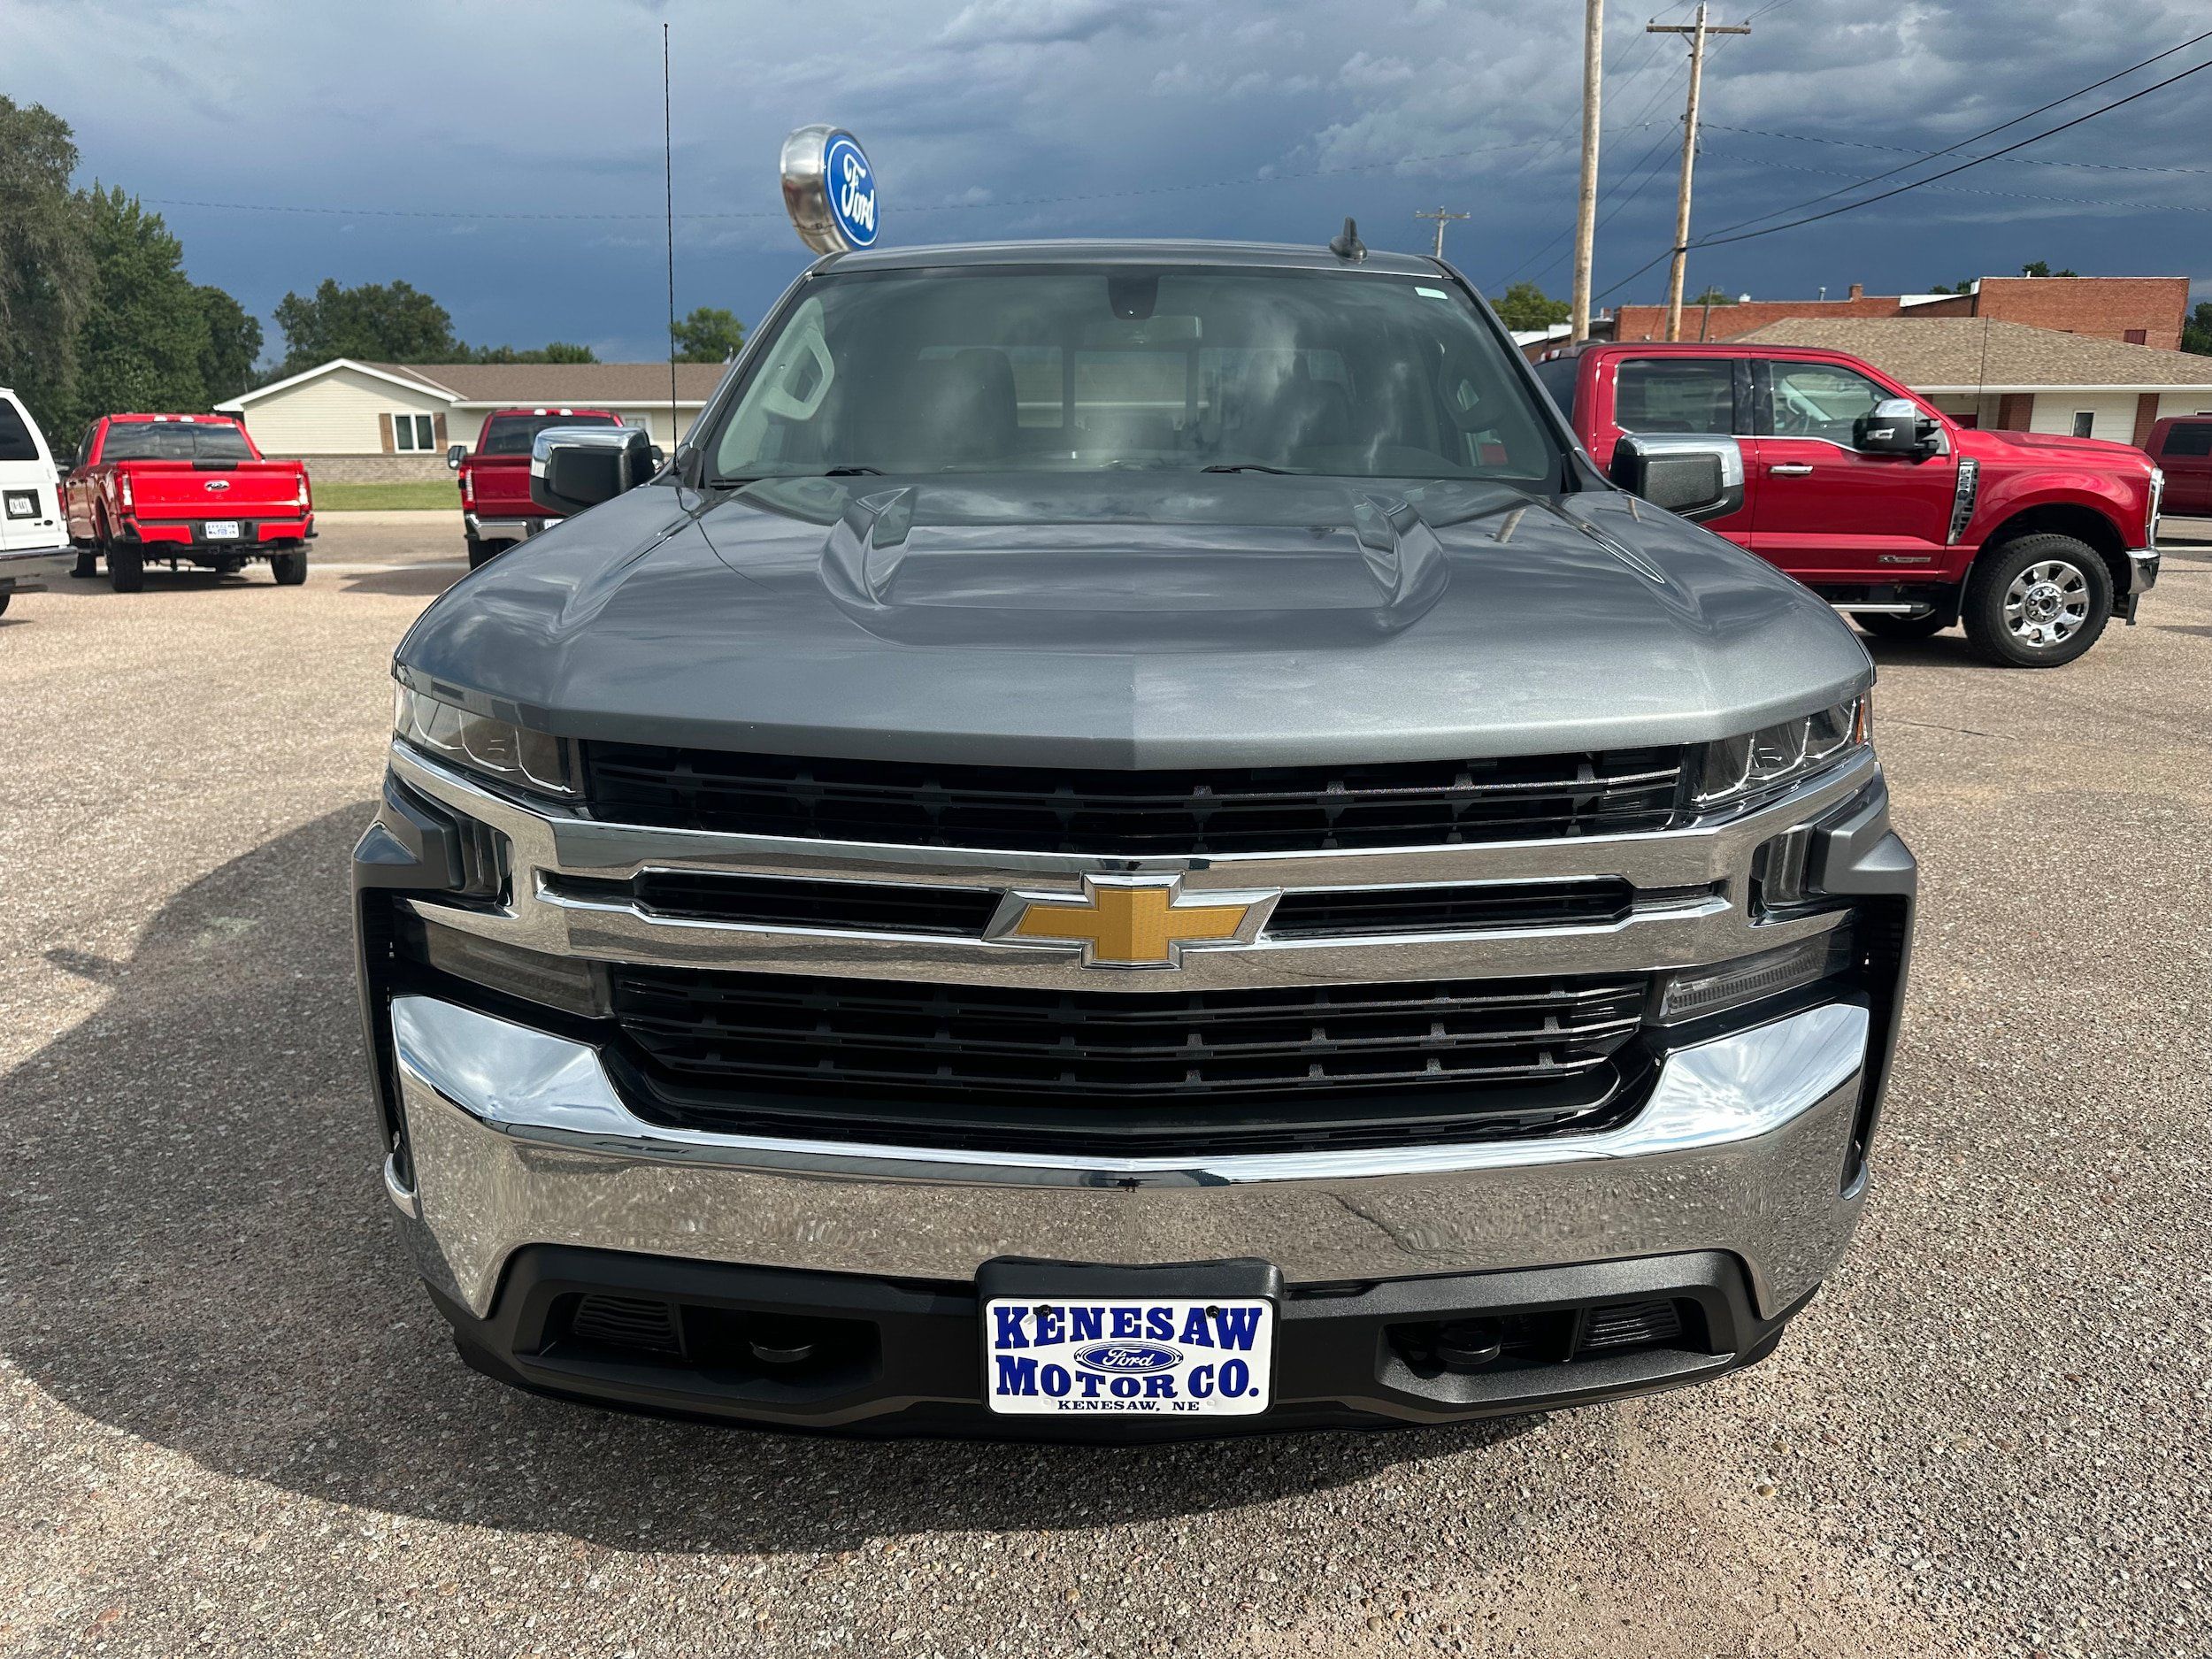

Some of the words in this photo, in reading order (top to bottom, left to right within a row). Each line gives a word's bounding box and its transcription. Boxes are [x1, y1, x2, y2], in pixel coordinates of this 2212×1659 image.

[841, 153, 875, 232] Ford
[993, 1306, 1263, 1351] KENESAW
[995, 1355, 1179, 1398] MOTOR
[1187, 1358, 1260, 1399] CO.
[1102, 1348, 1156, 1366] Ford
[1057, 1400, 1160, 1412] KENESAW,
[1171, 1401, 1200, 1411] NE
